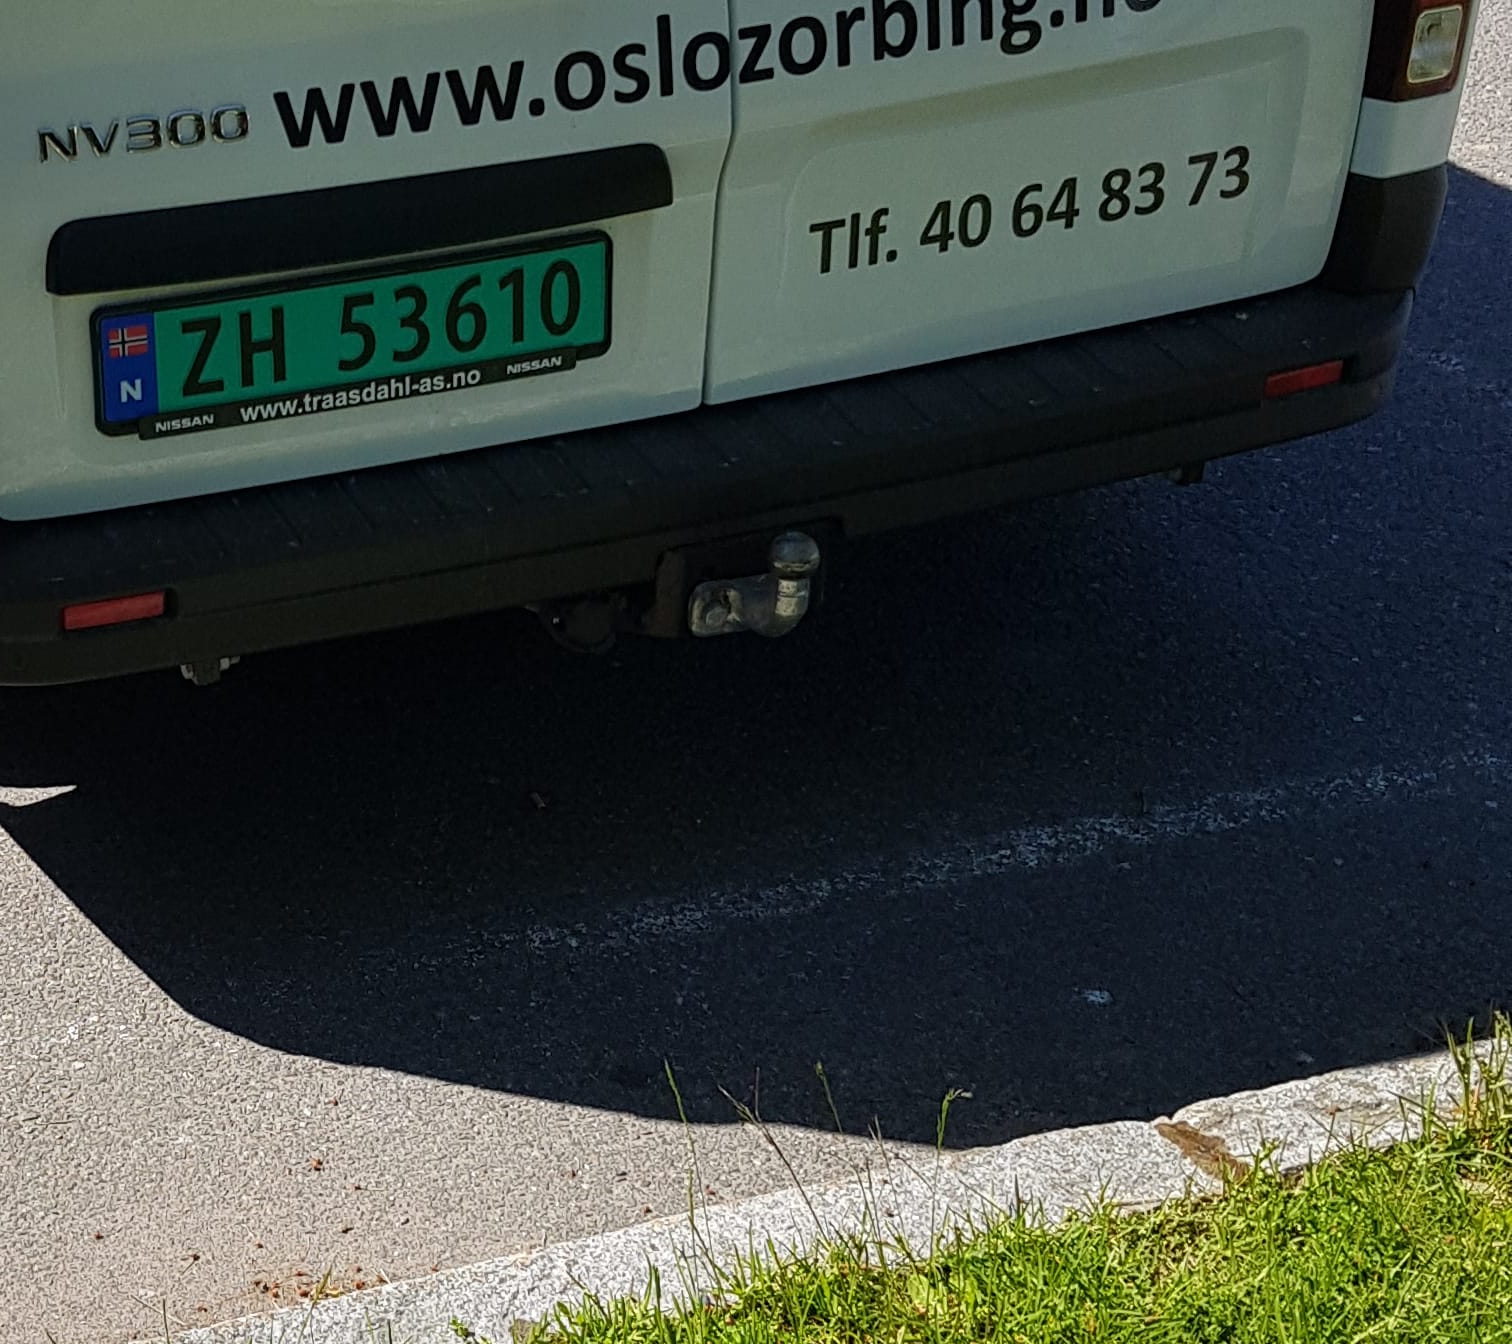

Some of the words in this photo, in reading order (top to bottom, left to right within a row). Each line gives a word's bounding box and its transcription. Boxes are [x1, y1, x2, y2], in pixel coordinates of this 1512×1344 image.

[38, 104, 250, 164] NV300
[809, 207, 898, 274] Tlf.
[919, 193, 992, 253] 40
[1011, 176, 1080, 238] 64
[1098, 161, 1166, 222] 83
[1187, 145, 1251, 206] 73
[180, 306, 288, 398] ZH
[337, 259, 582, 373] 53610
[119, 378, 143, 403] N
[154, 413, 215, 433] NISSAN
[240, 367, 482, 424] www.traasdahl-as.no
[506, 356, 563, 376] NISSAN
